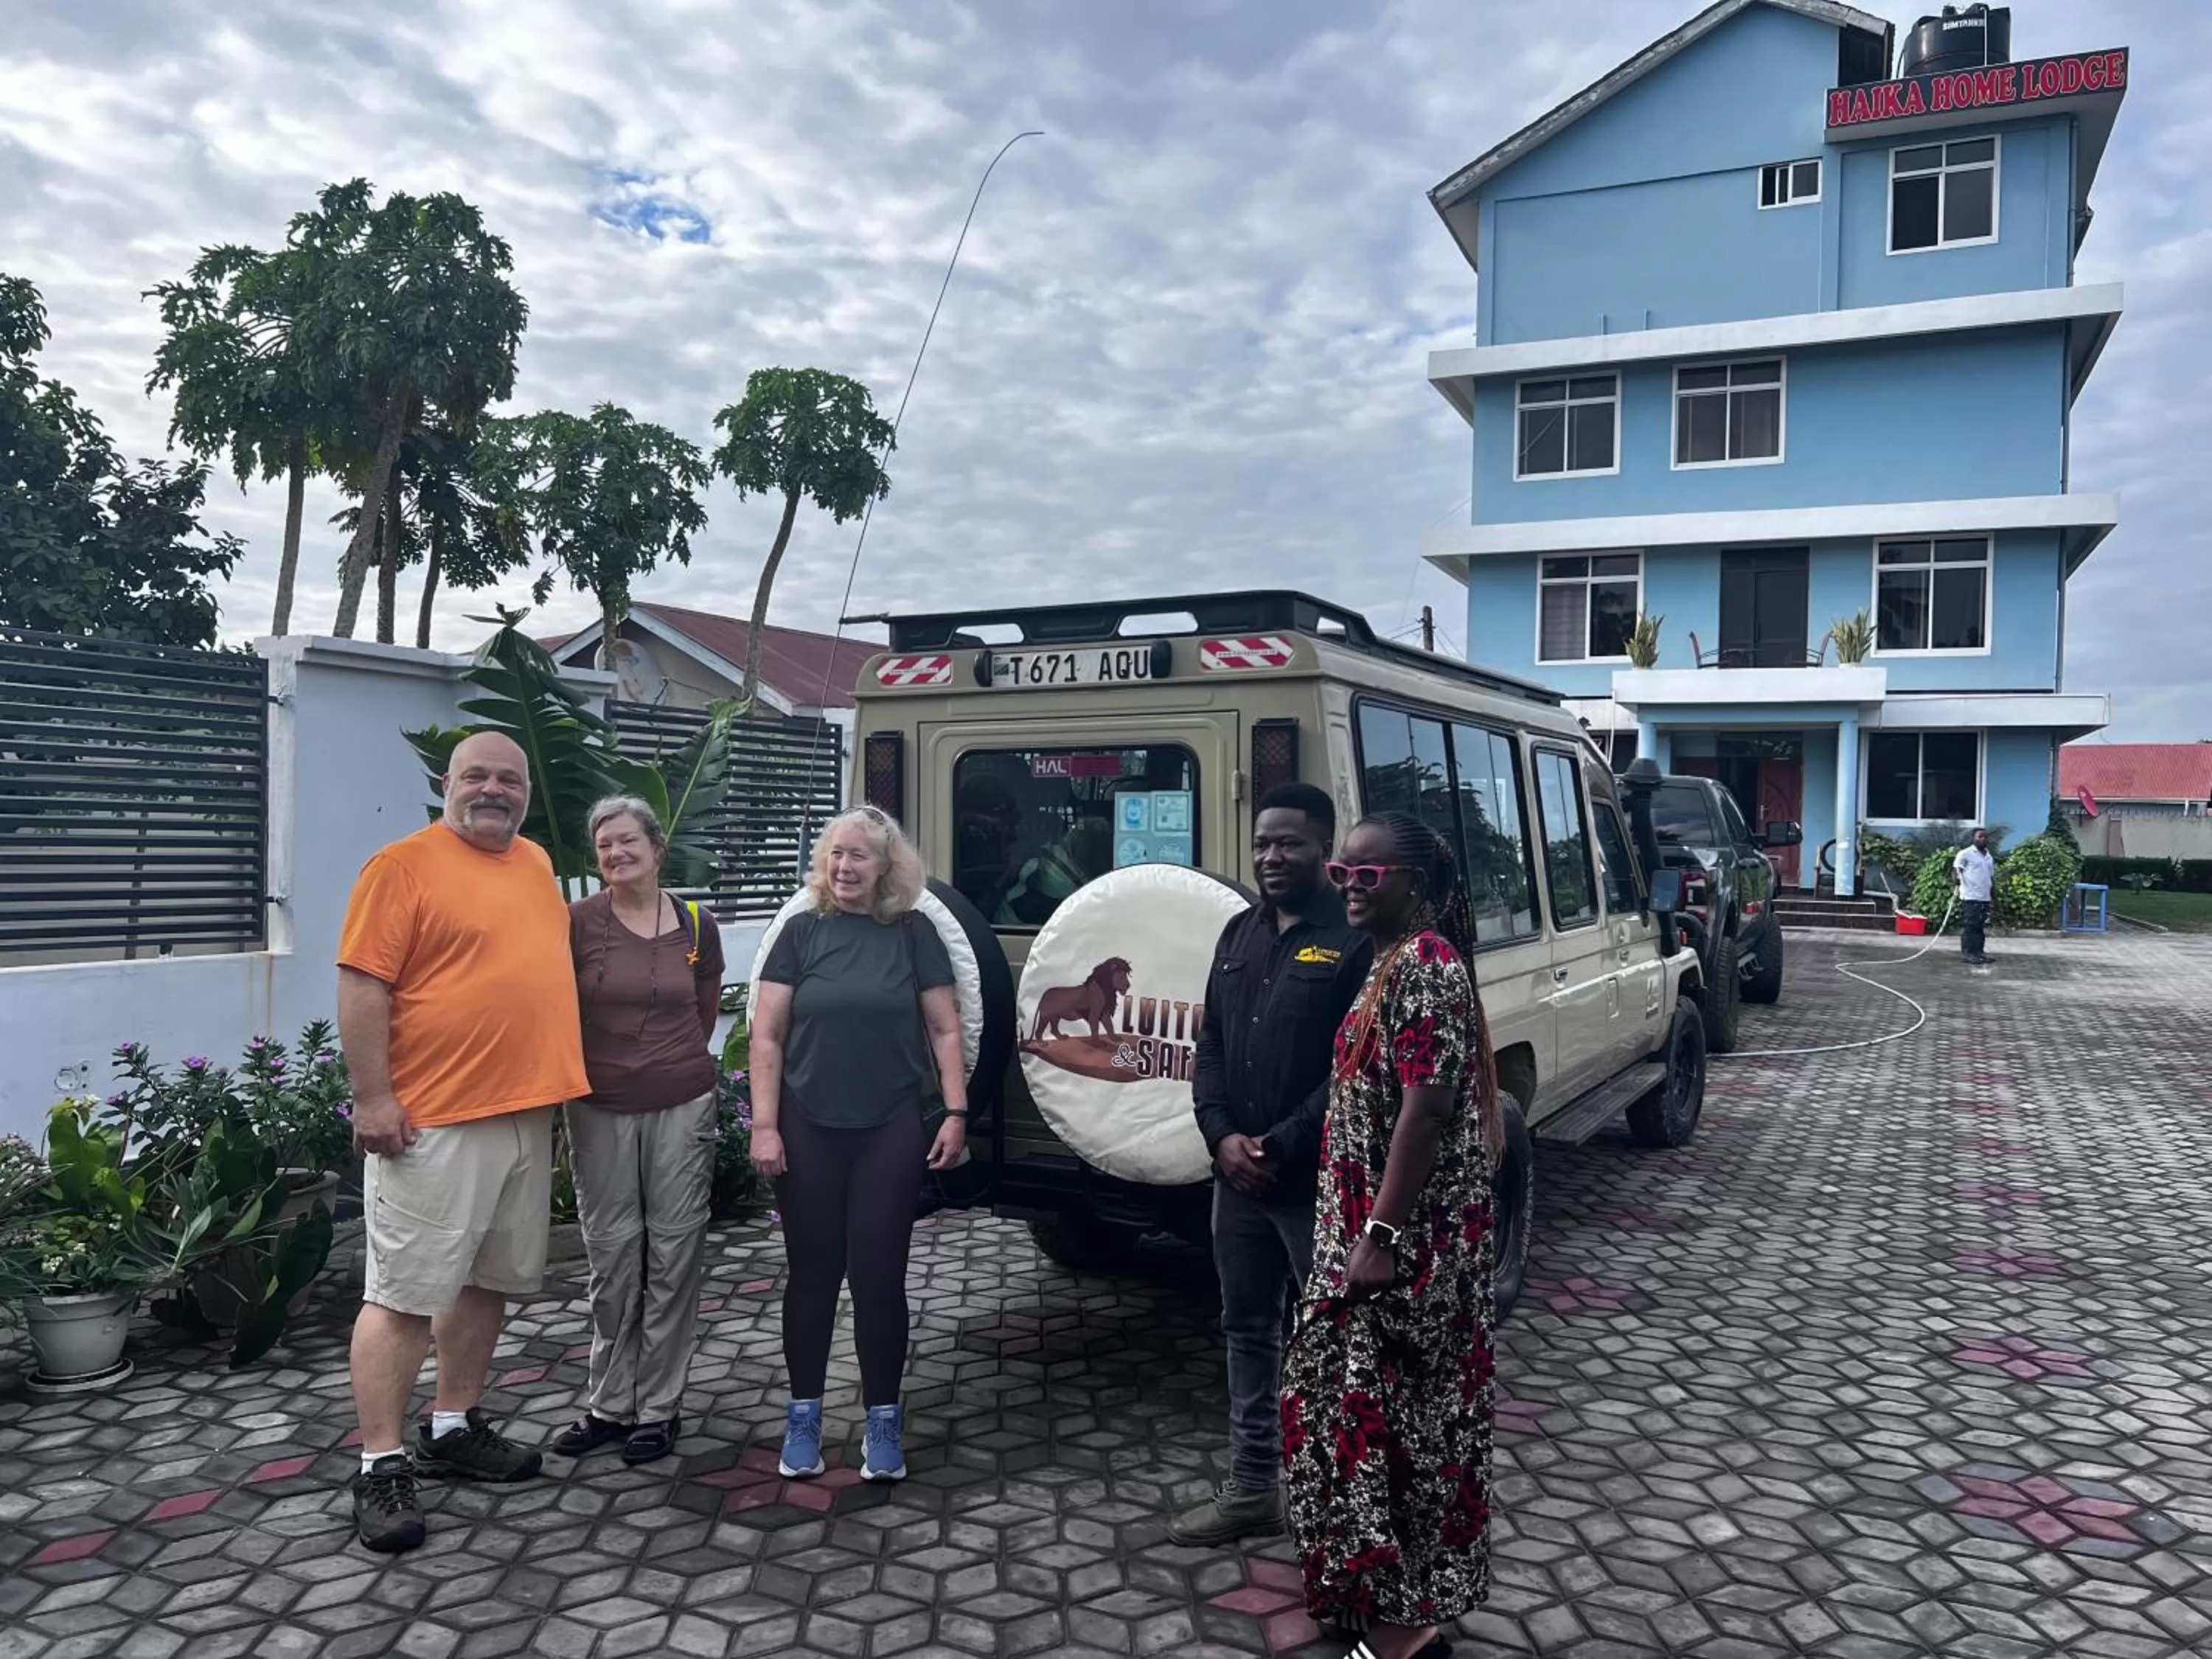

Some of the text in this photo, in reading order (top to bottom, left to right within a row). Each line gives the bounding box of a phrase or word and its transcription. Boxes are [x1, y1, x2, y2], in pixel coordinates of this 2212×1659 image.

[1829, 52, 2126, 126] HAIKA HOME LODGE
[1031, 654, 1077, 684] 671
[1099, 650, 1149, 681] AQU
